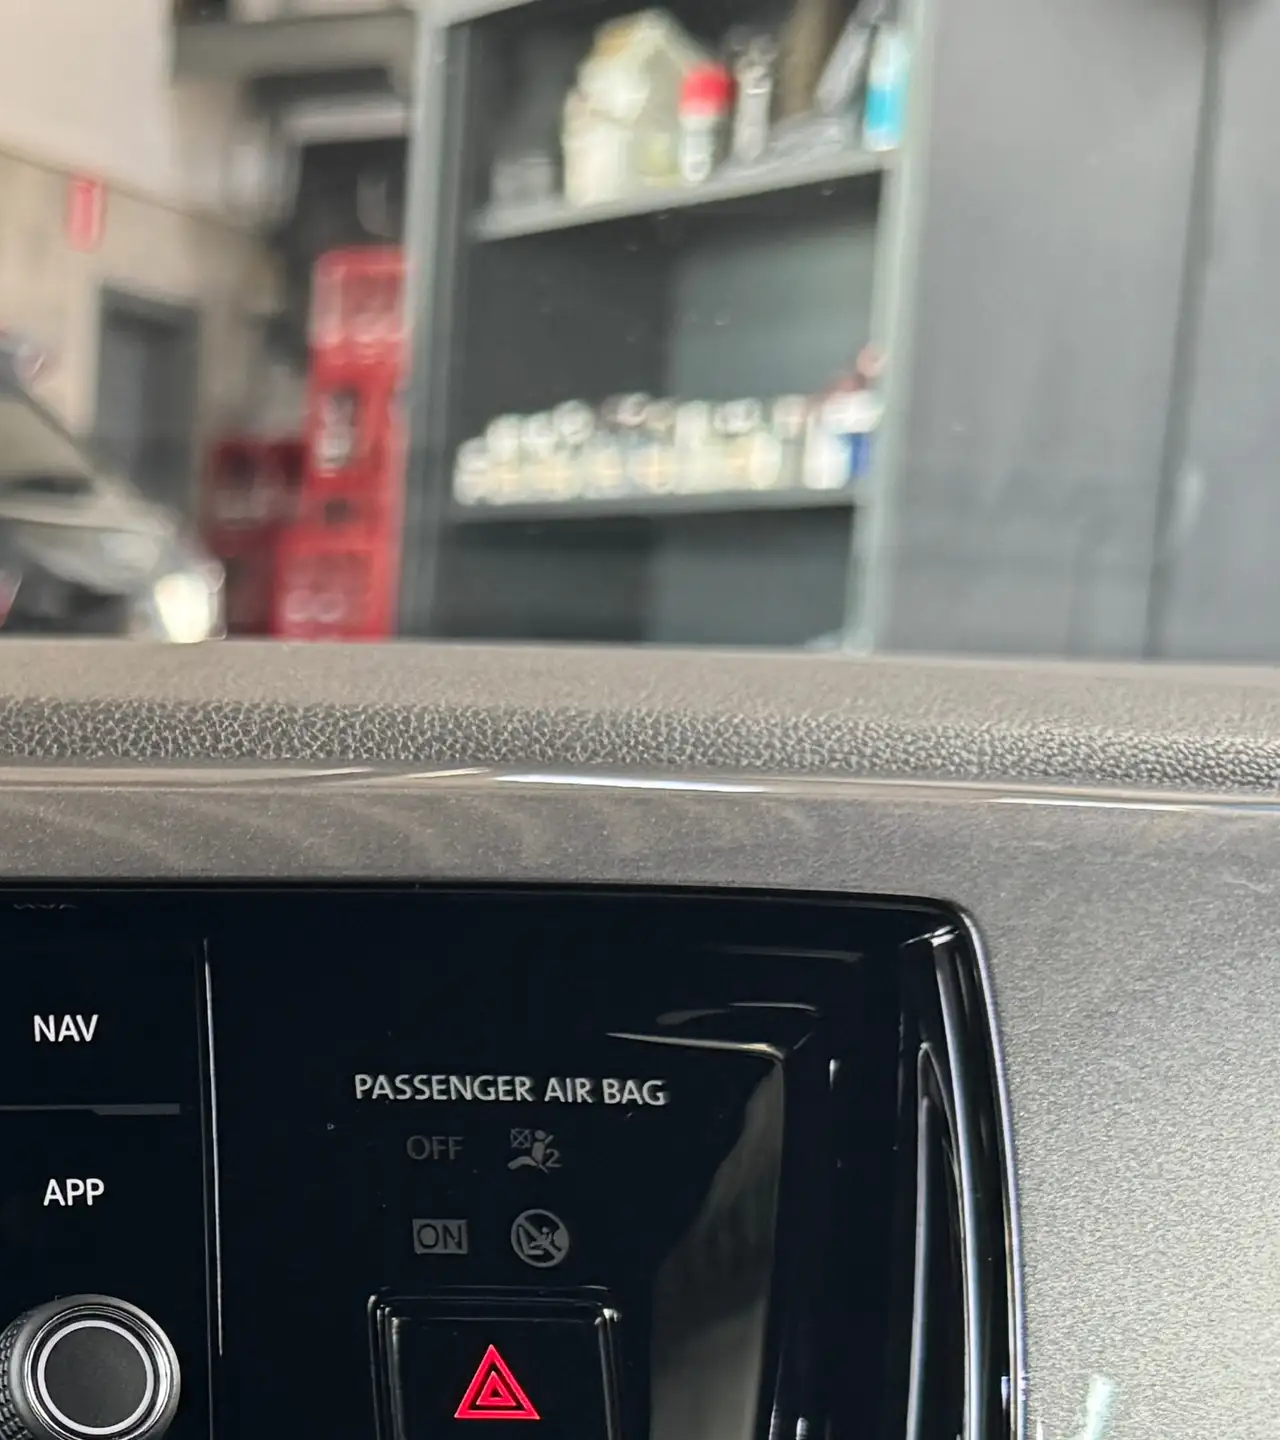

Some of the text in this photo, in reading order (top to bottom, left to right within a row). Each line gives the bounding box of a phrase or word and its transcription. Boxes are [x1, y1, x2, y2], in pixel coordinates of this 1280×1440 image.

[33, 1014, 99, 1042] NAV
[354, 1074, 668, 1106] PASSENGER AIR BAG
[406, 1135, 464, 1160] OFF
[43, 1177, 105, 1207] APP
[416, 1223, 464, 1251] ON
